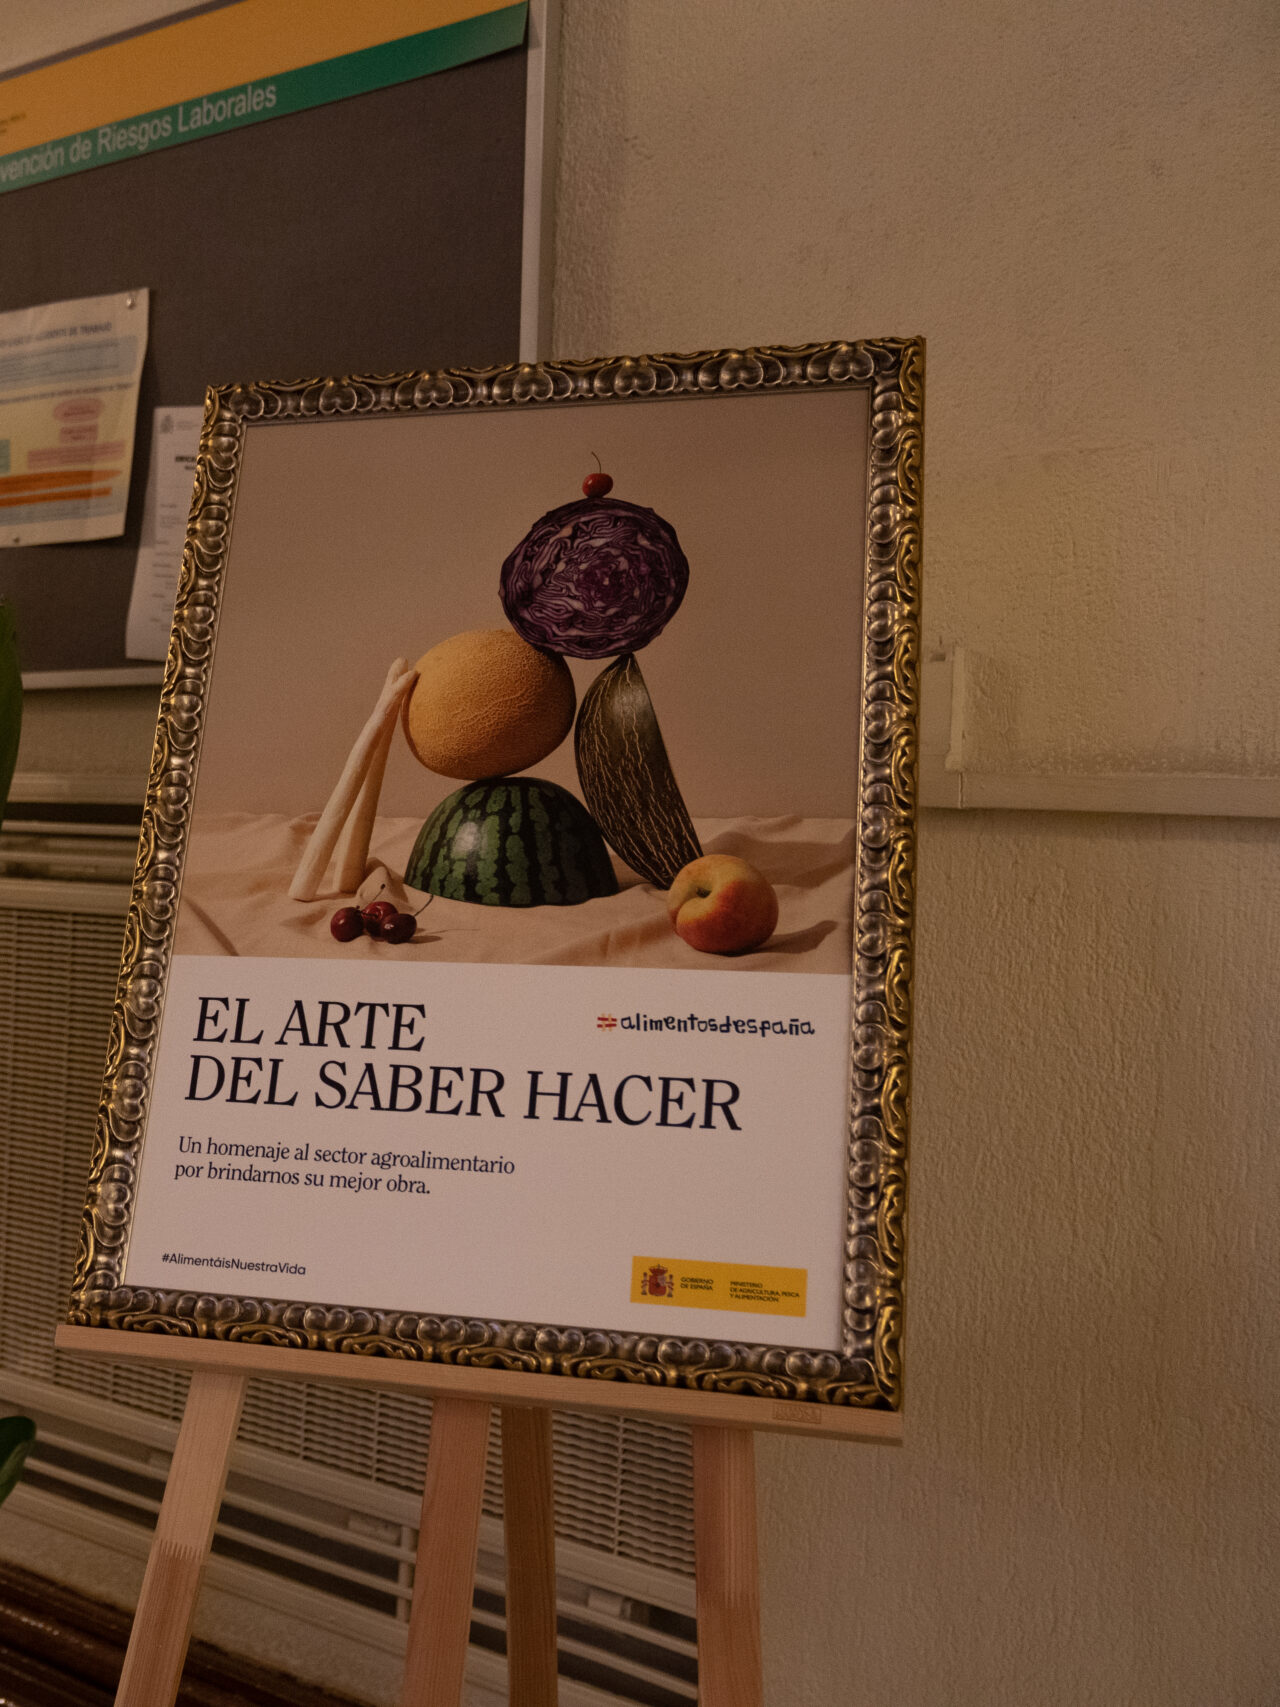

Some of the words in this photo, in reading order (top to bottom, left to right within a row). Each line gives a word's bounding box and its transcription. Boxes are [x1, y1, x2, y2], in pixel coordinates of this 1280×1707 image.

[70, 138, 92, 163] de
[97, 113, 172, 155] Riesgos
[177, 86, 277, 133] Laborales
[193, 997, 264, 1045] EL
[274, 999, 426, 1052] ARTE
[184, 1054, 299, 1107] DEL
[314, 1060, 505, 1118] SABER
[523, 1070, 742, 1131] HACER
[174, 1163, 204, 1181] por
[207, 1161, 300, 1186] brindarnos
[304, 1172, 324, 1187] su
[329, 1173, 382, 1193] mejor
[386, 1175, 431, 1195] obra.
[178, 1135, 202, 1154] Un
[207, 1137, 290, 1162] homenaje
[294, 1143, 309, 1161] al
[313, 1146, 367, 1165] sector
[370, 1150, 516, 1175] agroalimentario
[161, 1253, 306, 1276] #AlimentáisNuestraVida
